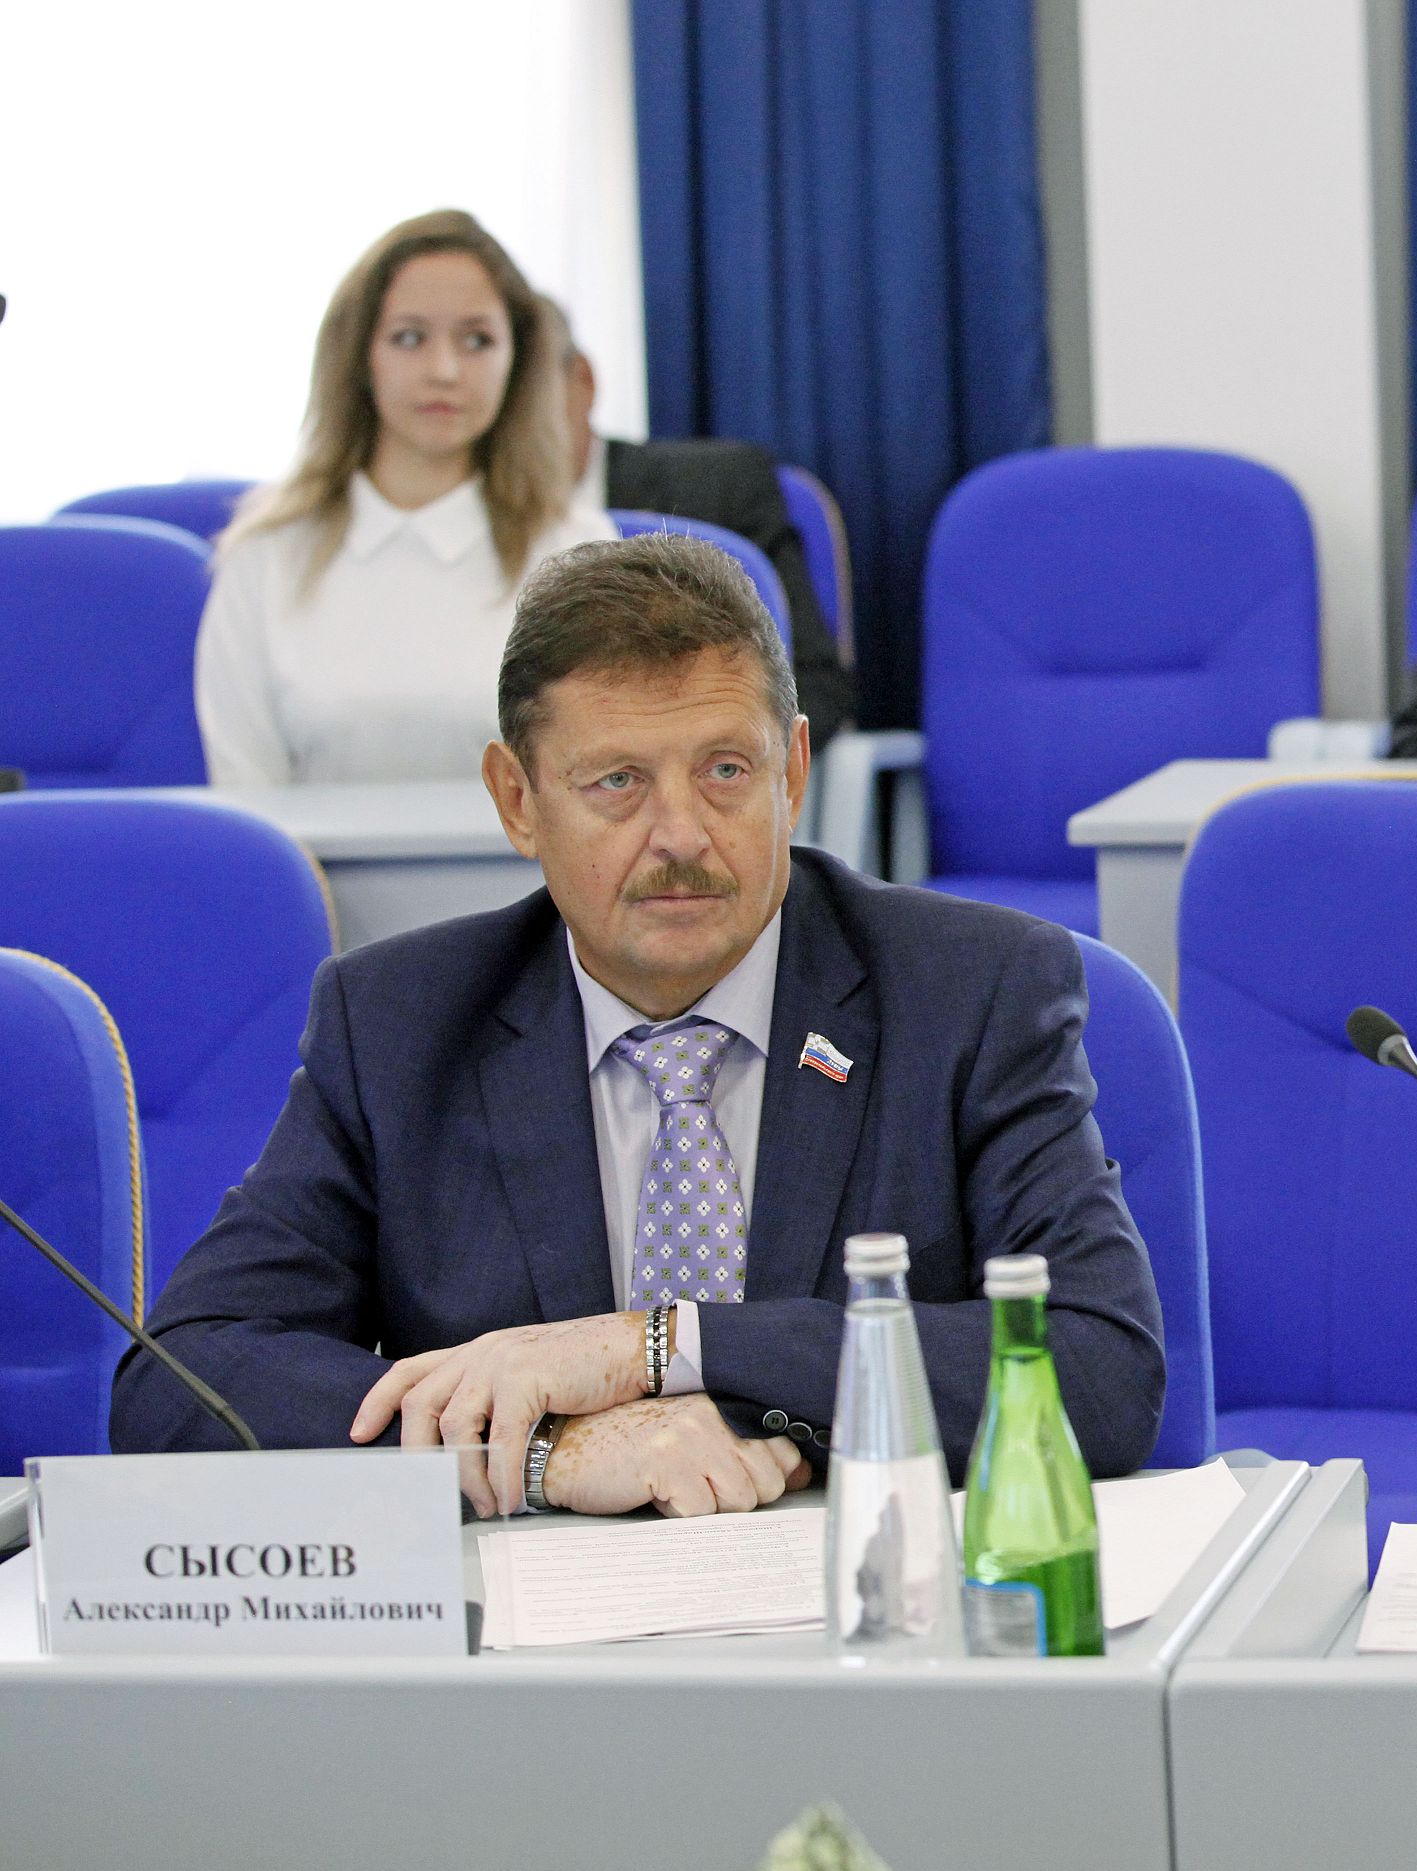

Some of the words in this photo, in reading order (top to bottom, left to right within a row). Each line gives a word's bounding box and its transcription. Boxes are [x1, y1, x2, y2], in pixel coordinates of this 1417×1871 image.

[143, 1543, 357, 1578] СЫСОЕВ
[63, 1597, 231, 1628] Александр
[242, 1596, 443, 1621] Михайлович
